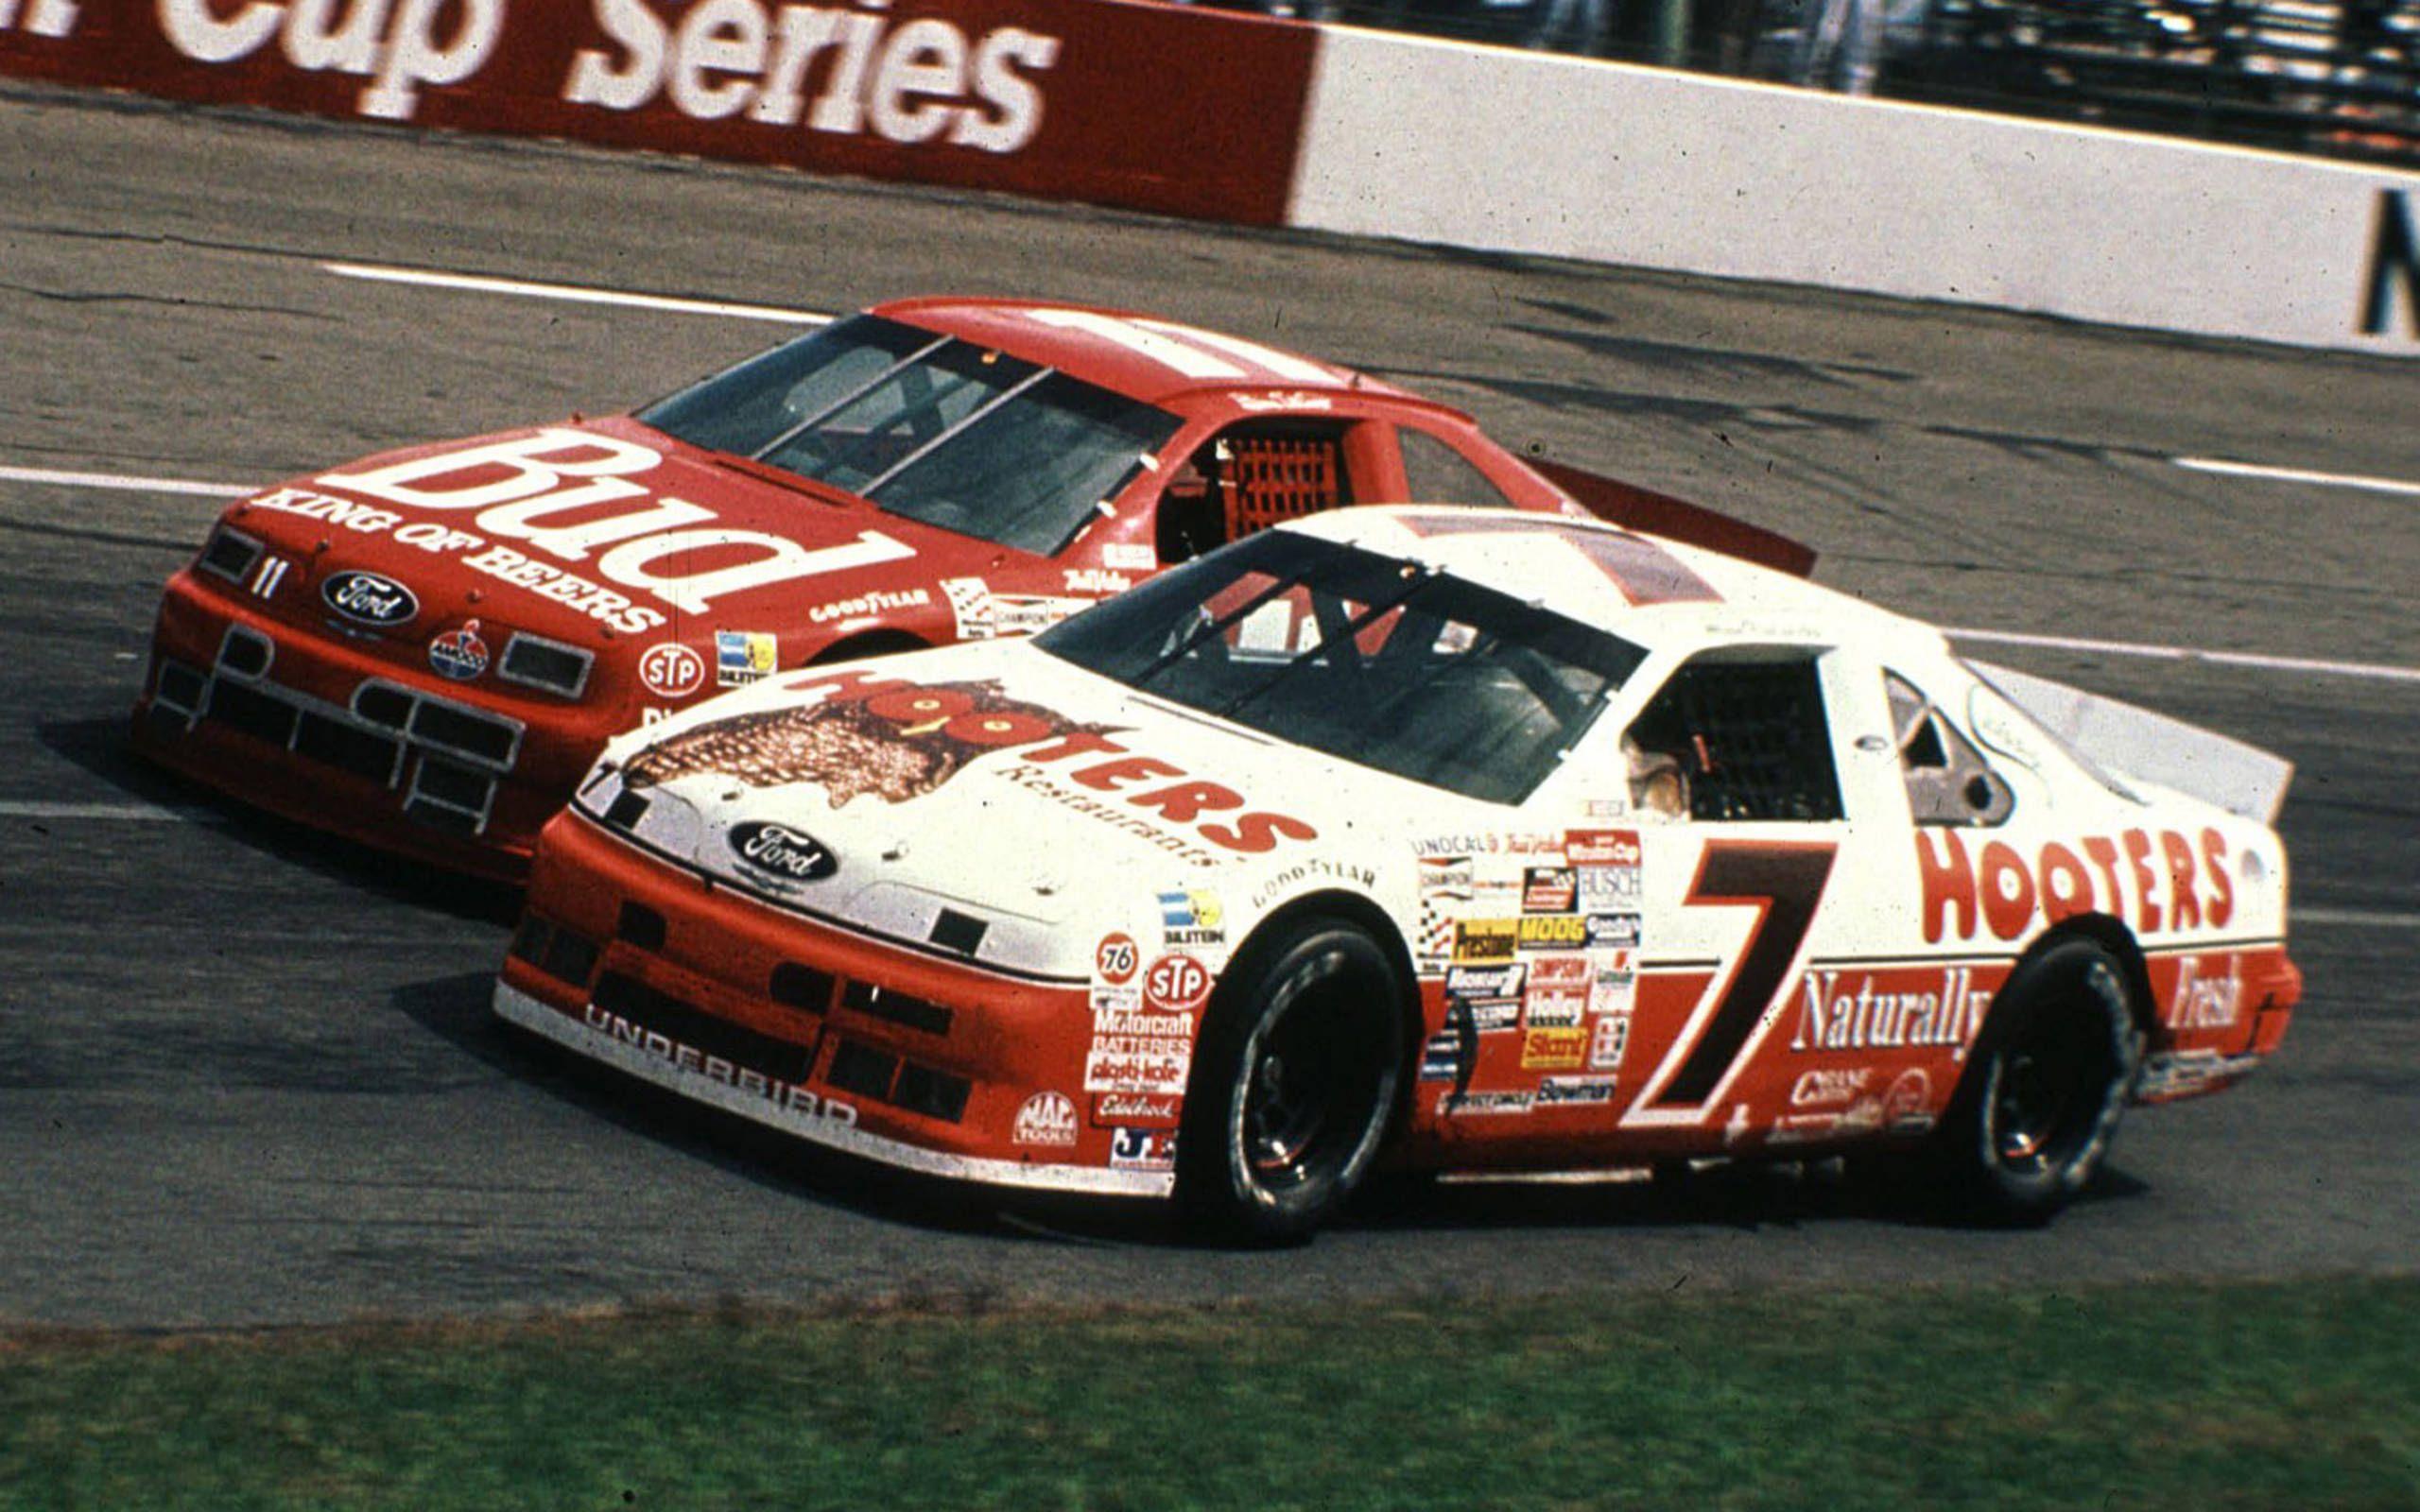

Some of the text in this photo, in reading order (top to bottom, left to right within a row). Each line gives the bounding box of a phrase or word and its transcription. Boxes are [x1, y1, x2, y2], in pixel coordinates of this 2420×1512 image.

[564, 0, 1063, 154] Series
[315, 427, 916, 615] Bud
[251, 489, 666, 633] KING OF BEERS
[251, 557, 289, 599] 11
[336, 576, 403, 619] Ford
[809, 589, 931, 623] GOODYEAR
[648, 649, 696, 687] STP
[743, 826, 822, 876] Ford
[1410, 835, 1486, 855] UNOCAL
[1580, 867, 1642, 896] BUSCH
[1917, 828, 2235, 944] HOOTERS
[1164, 930, 1225, 944] BILSTEIN
[1519, 919, 1586, 941] MOOG
[1100, 946, 1132, 971] 76
[1151, 958, 1202, 1002] STP
[1618, 837, 1840, 1128] 7
[1094, 1006, 1194, 1037] Motorcraft
[1790, 966, 1992, 1062] Naturally
[1092, 1035, 1191, 1057] BATTERIES
